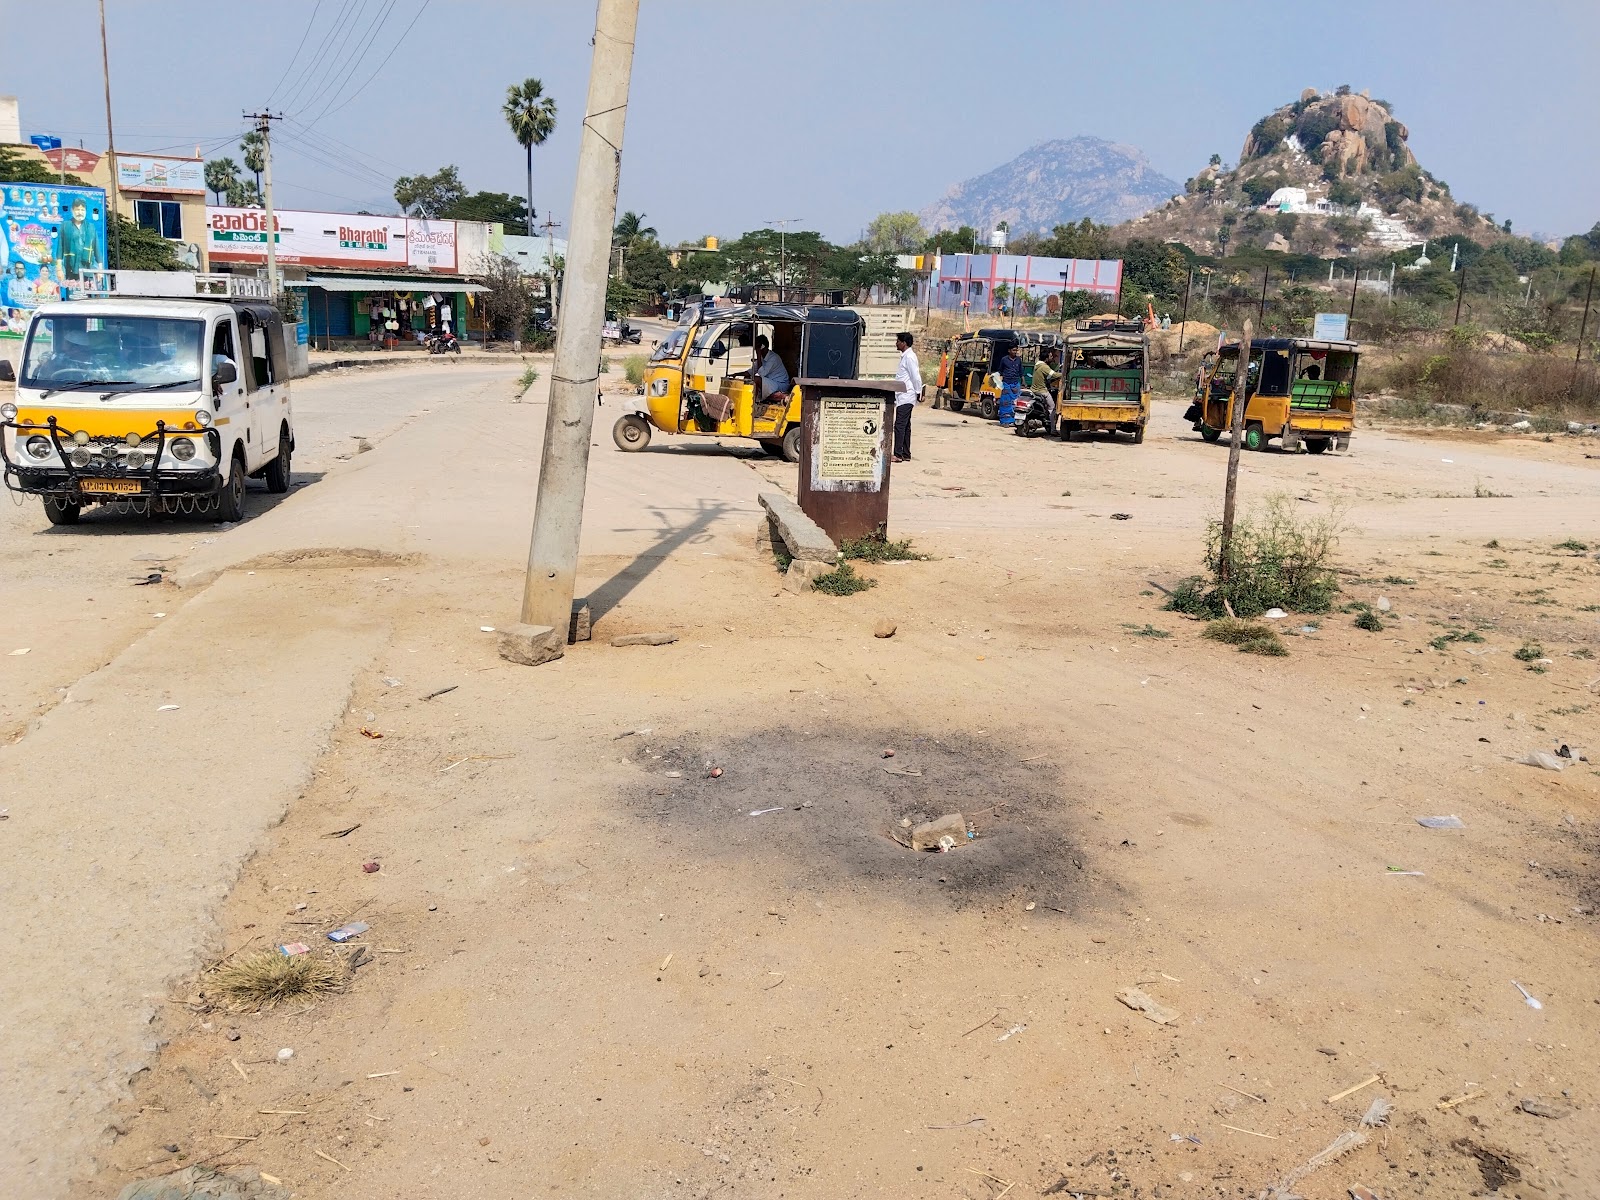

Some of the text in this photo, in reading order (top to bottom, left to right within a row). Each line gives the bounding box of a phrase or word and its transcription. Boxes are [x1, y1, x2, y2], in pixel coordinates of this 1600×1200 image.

[212, 212, 279, 233] భారతి
[232, 233, 261, 241] సిమెంట్
[339, 226, 387, 247] Bharathi
[340, 241, 387, 249] CEMENT
[80, 481, 139, 491] AP.03TV.0521
